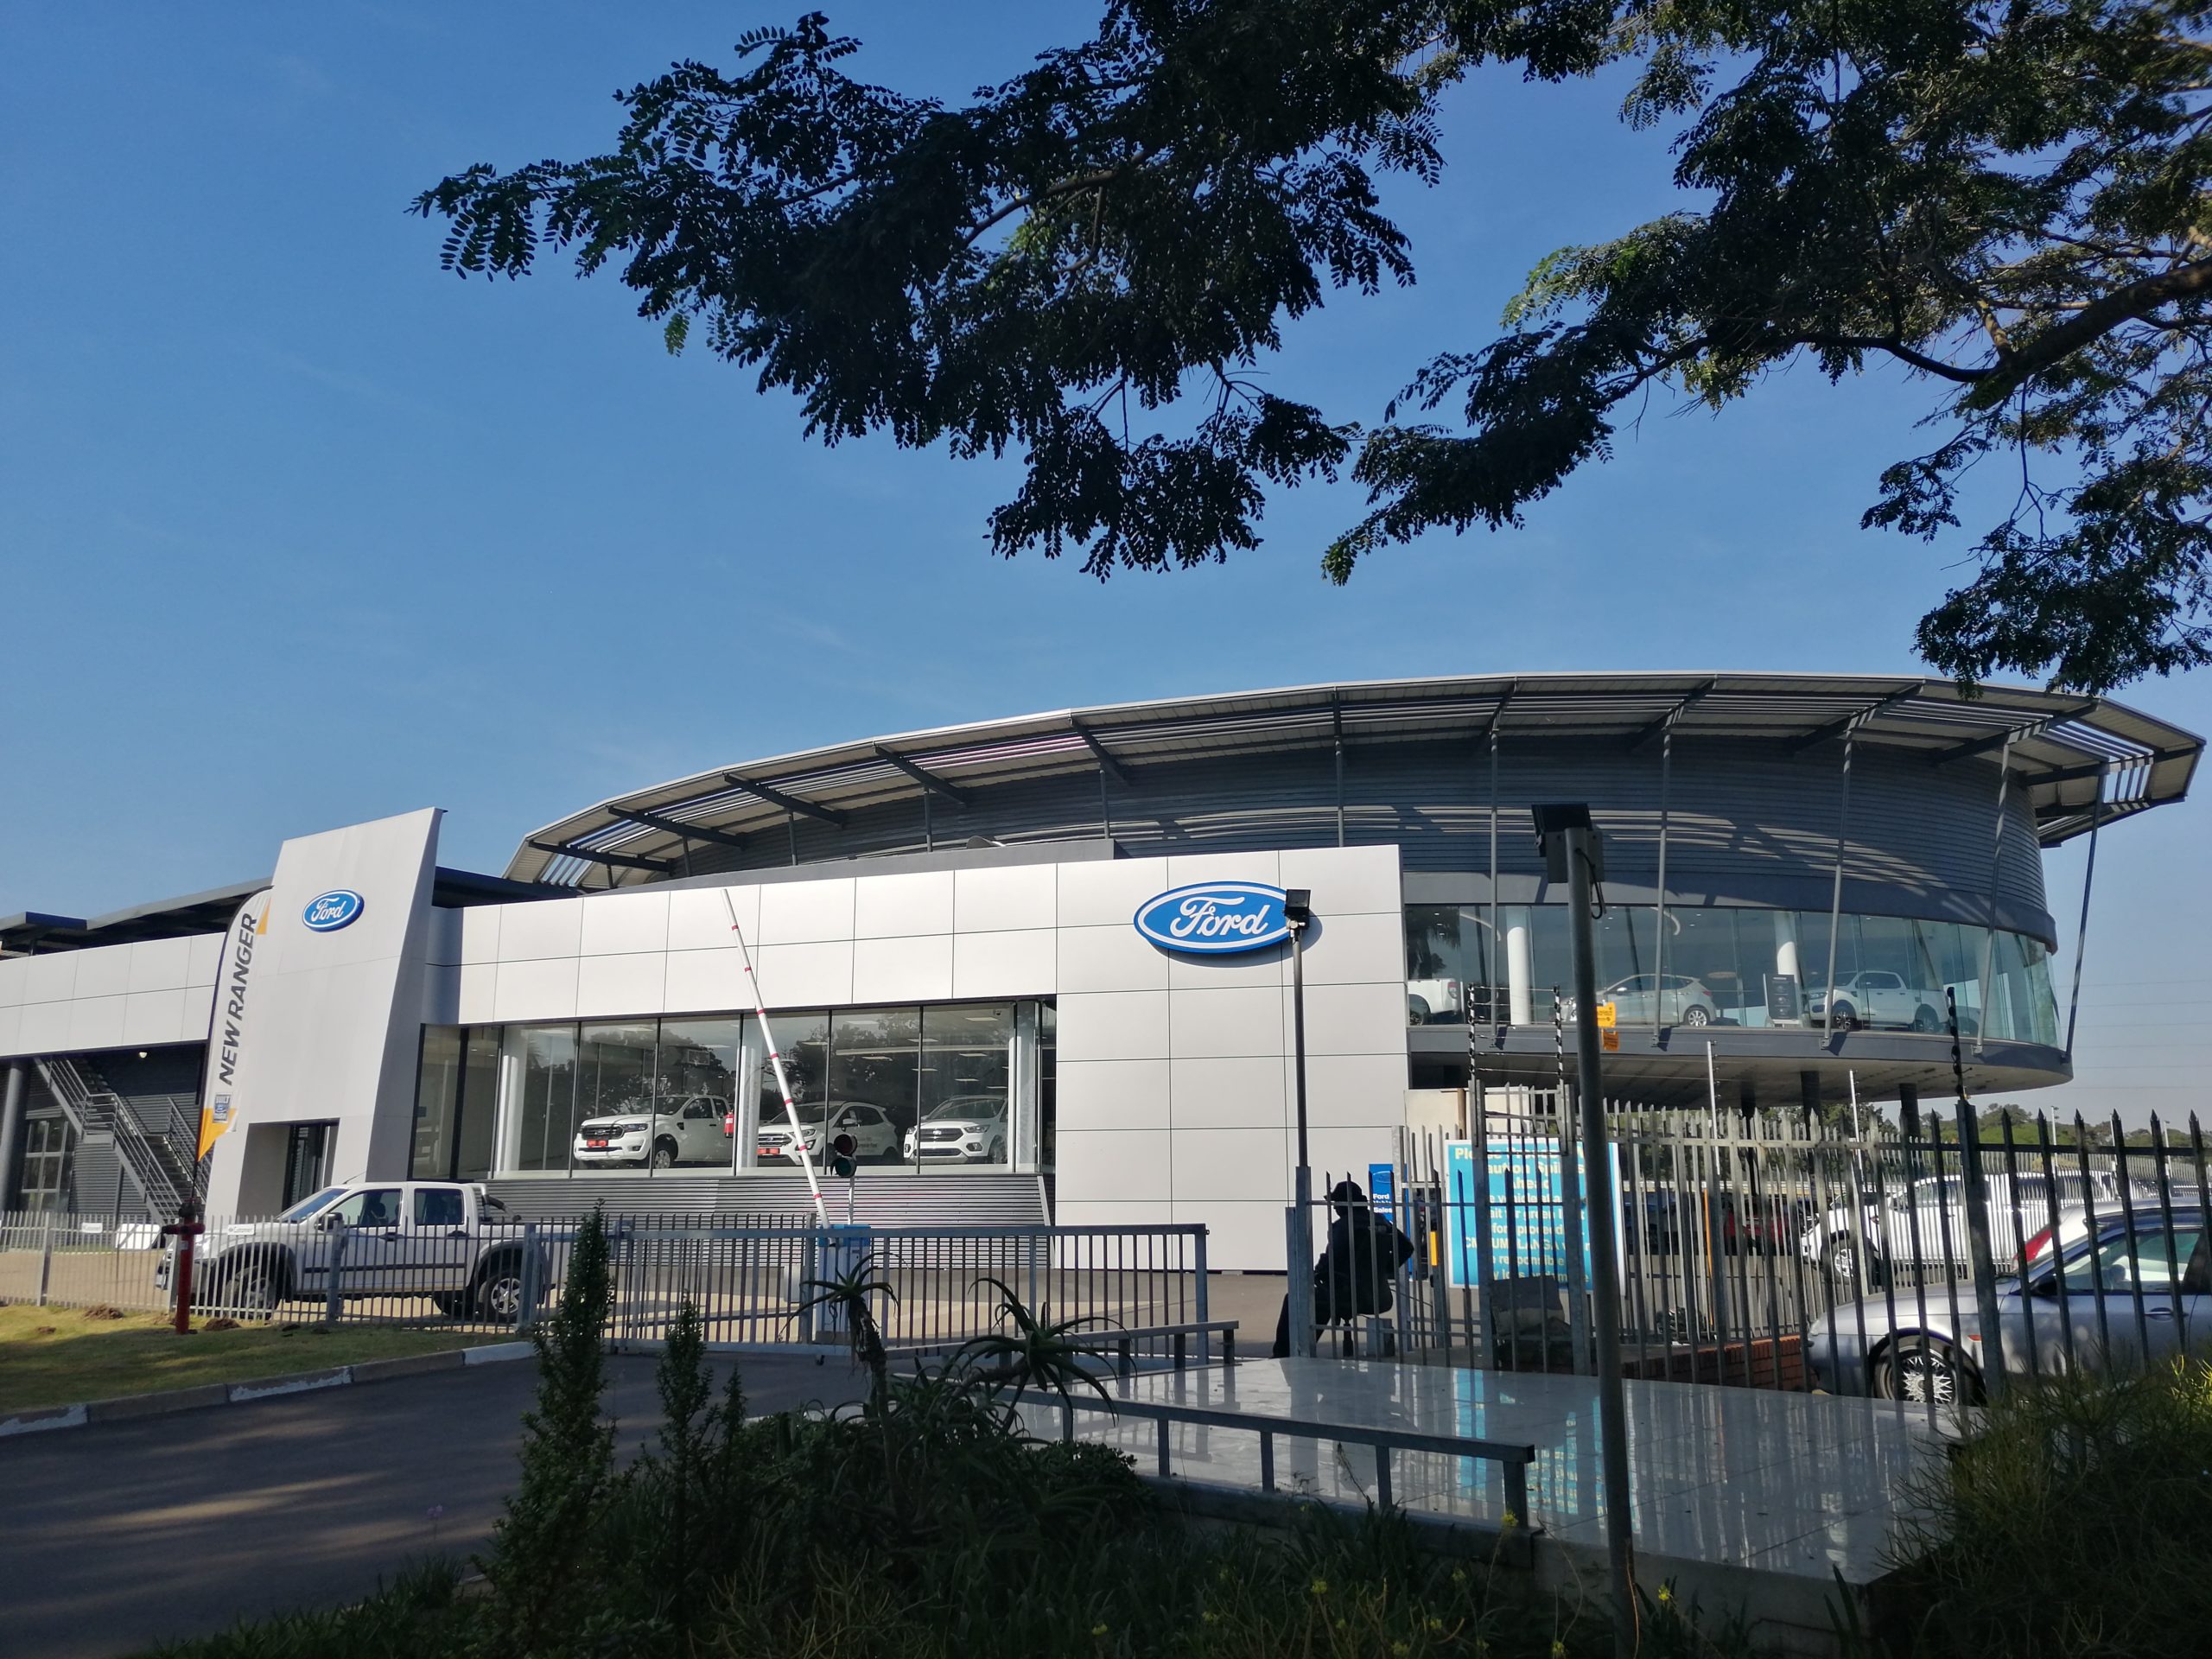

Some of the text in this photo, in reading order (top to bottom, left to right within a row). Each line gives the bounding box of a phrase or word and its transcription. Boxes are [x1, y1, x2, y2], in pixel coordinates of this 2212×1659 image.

[311, 897, 346, 922] Ford
[1169, 896, 1271, 938] Ford
[227, 912, 257, 1020] RANGER
[219, 1020, 240, 1086] NEW
[1488, 1161, 1586, 1176] auton Spis
